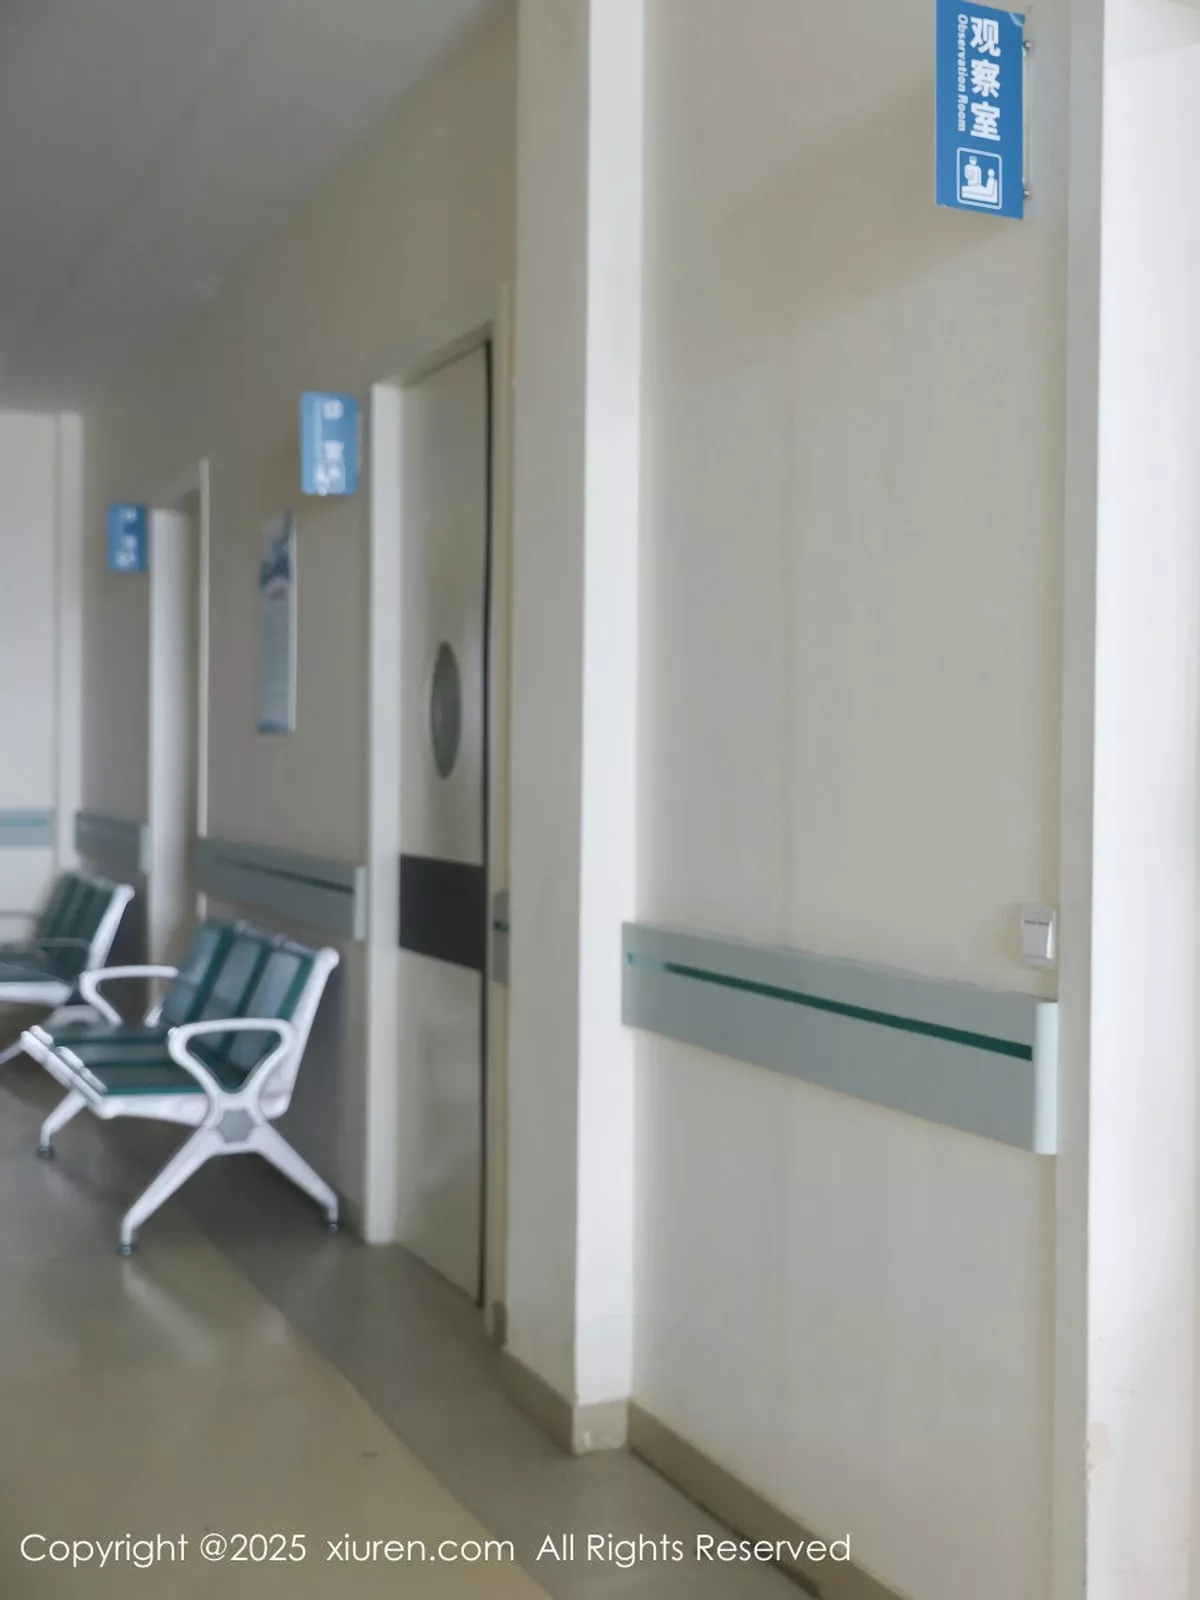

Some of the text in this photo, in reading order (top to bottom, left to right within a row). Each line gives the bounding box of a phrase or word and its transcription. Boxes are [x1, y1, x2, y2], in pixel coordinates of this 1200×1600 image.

[957, 13, 969, 132] Observation Room
[969, 16, 1001, 141] 观察室
